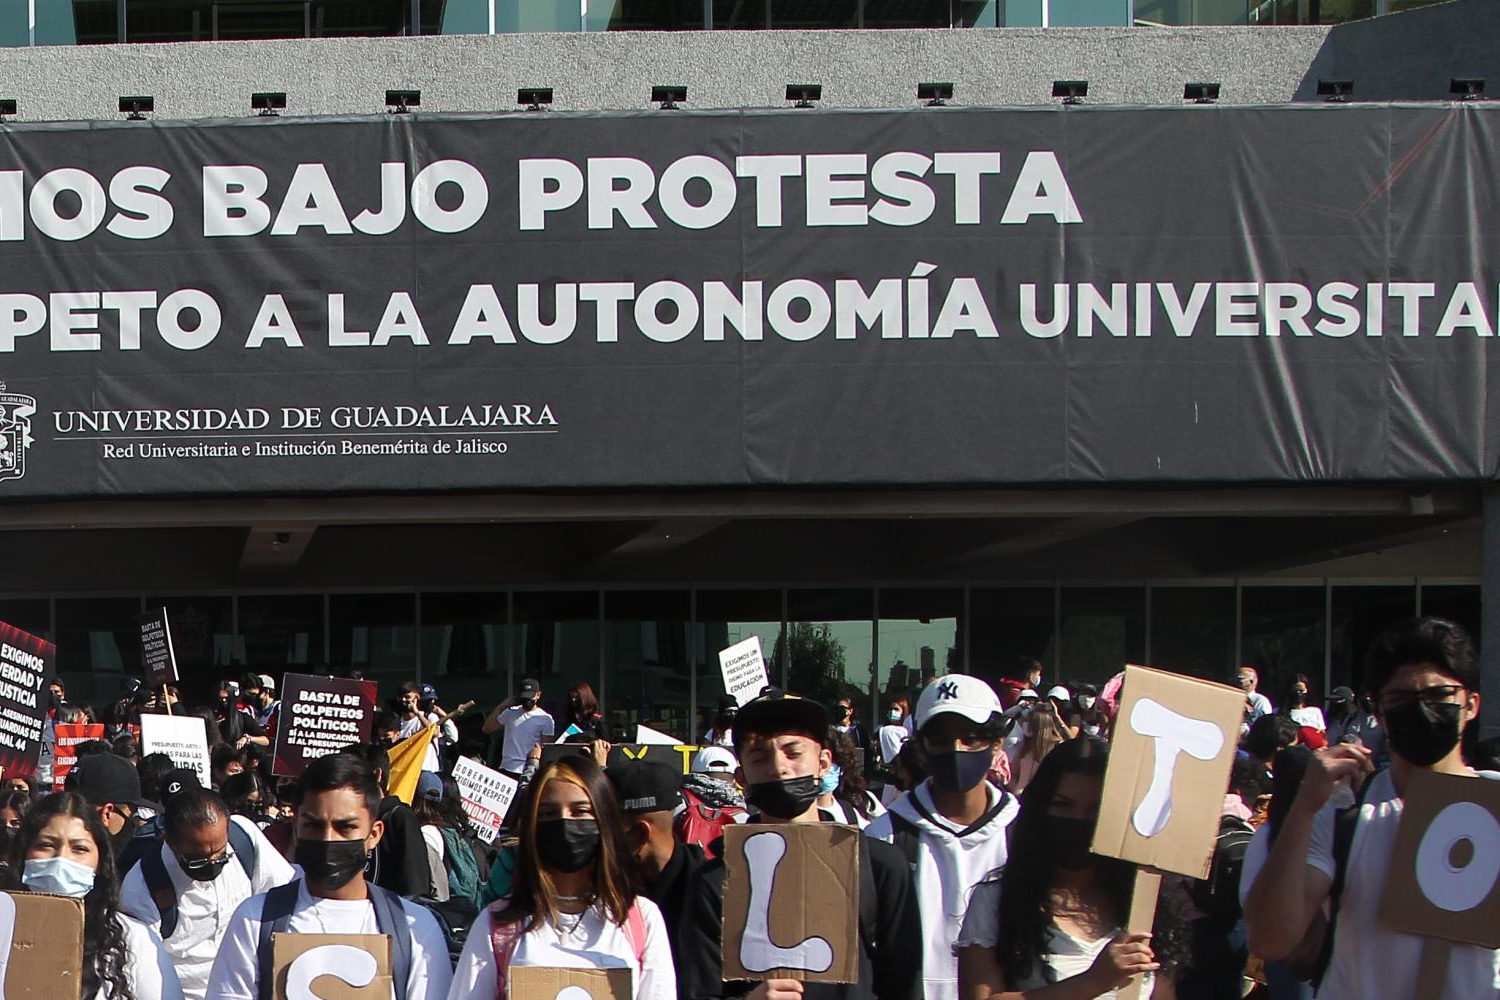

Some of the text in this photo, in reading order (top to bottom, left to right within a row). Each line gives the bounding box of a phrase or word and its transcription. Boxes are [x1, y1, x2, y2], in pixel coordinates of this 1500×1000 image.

[202, 158, 489, 237] BAJO
[517, 151, 1084, 230] PROTESTA
[244, 294, 304, 348] A
[328, 292, 430, 347] LA
[447, 261, 999, 345] AUTONOMÍA
[1019, 281, 1500, 338] UNIVERSITA
[52, 403, 559, 433] UNIVERSIDAD DE GUADALAJARA
[103, 438, 508, 459] Red Universitaria e Institución Benemérita de Jalisco
[1, 643, 44, 672] EXIGIMOS
[36, 675, 44, 691] Y
[299, 690, 360, 707] BASTA DE
[2, 705, 33, 727] ASESINATO
[33, 717, 42, 730] DE
[292, 703, 364, 720] GOLPETEOS
[293, 716, 359, 733] POLÍTICOS.
[29, 728, 41, 742] DE
[287, 736, 296, 745] SÍ
[296, 738, 307, 746] AL
[289, 728, 361, 743] SÍ A LA EDUCACIÓN,
[14, 738, 27, 752] 44
[482, 787, 510, 806] RESPETO
